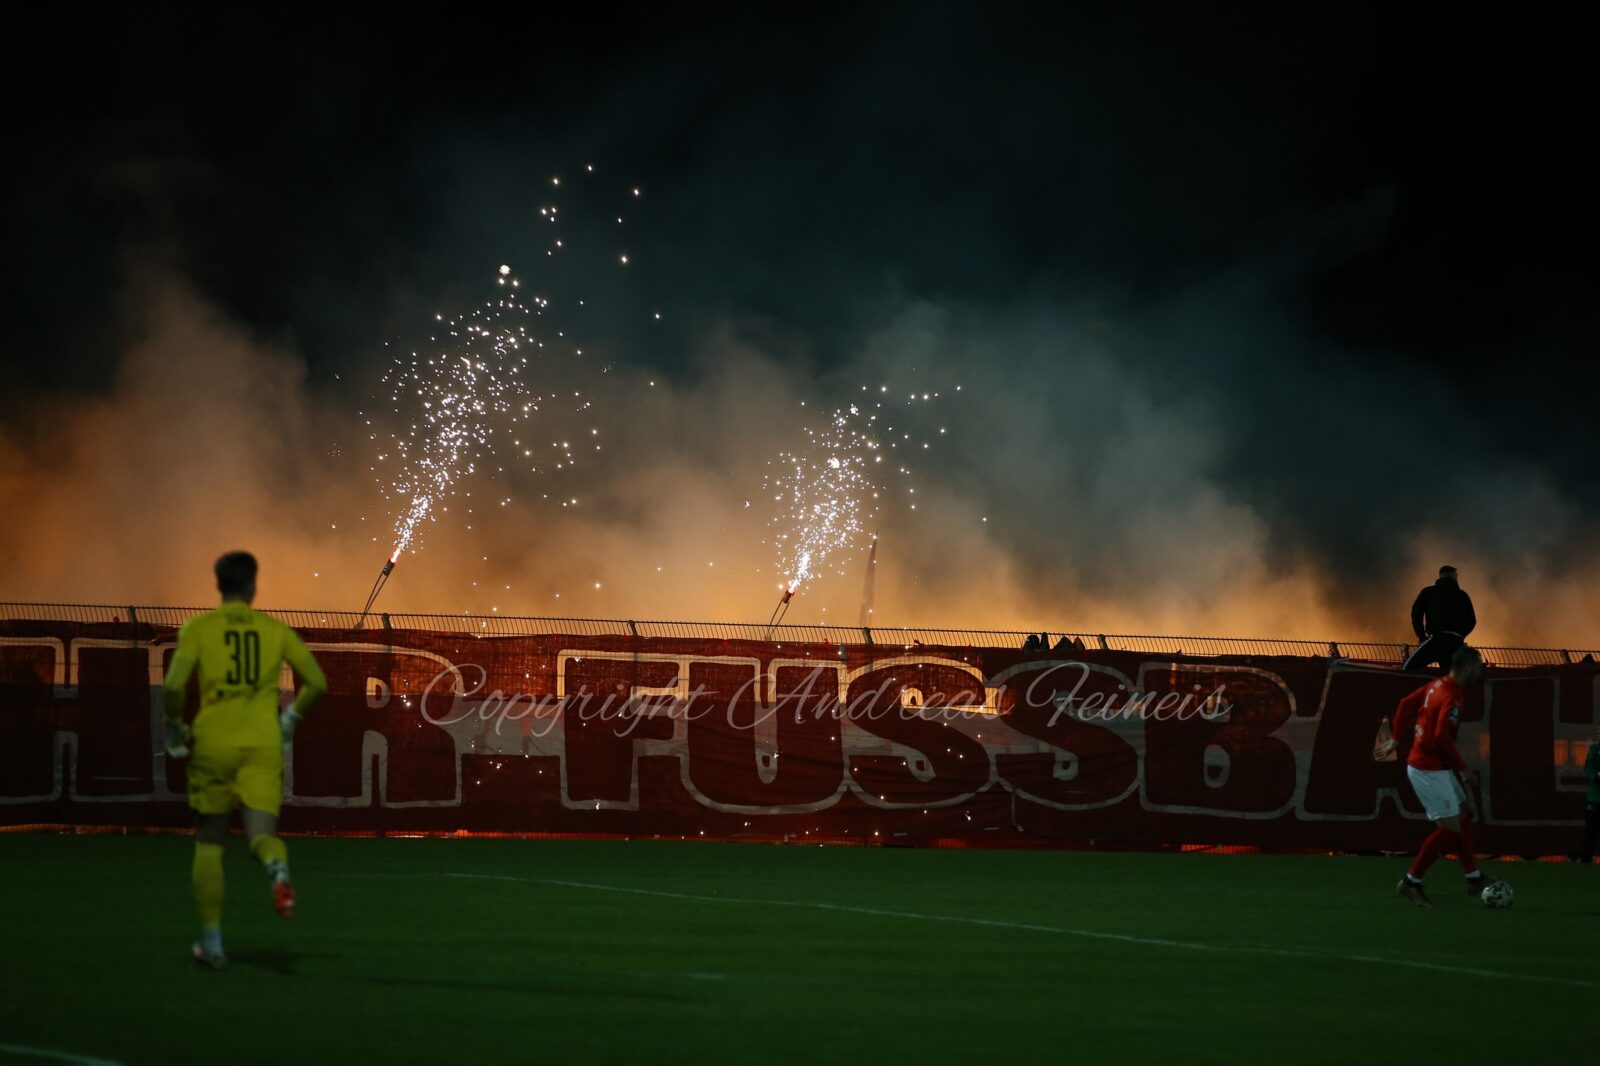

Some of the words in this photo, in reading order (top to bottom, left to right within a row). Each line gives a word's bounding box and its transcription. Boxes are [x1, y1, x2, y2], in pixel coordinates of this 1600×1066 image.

[224, 630, 259, 685] 30
[0, 635, 463, 809] HR
[556, 648, 1600, 827] FUSSBAL
